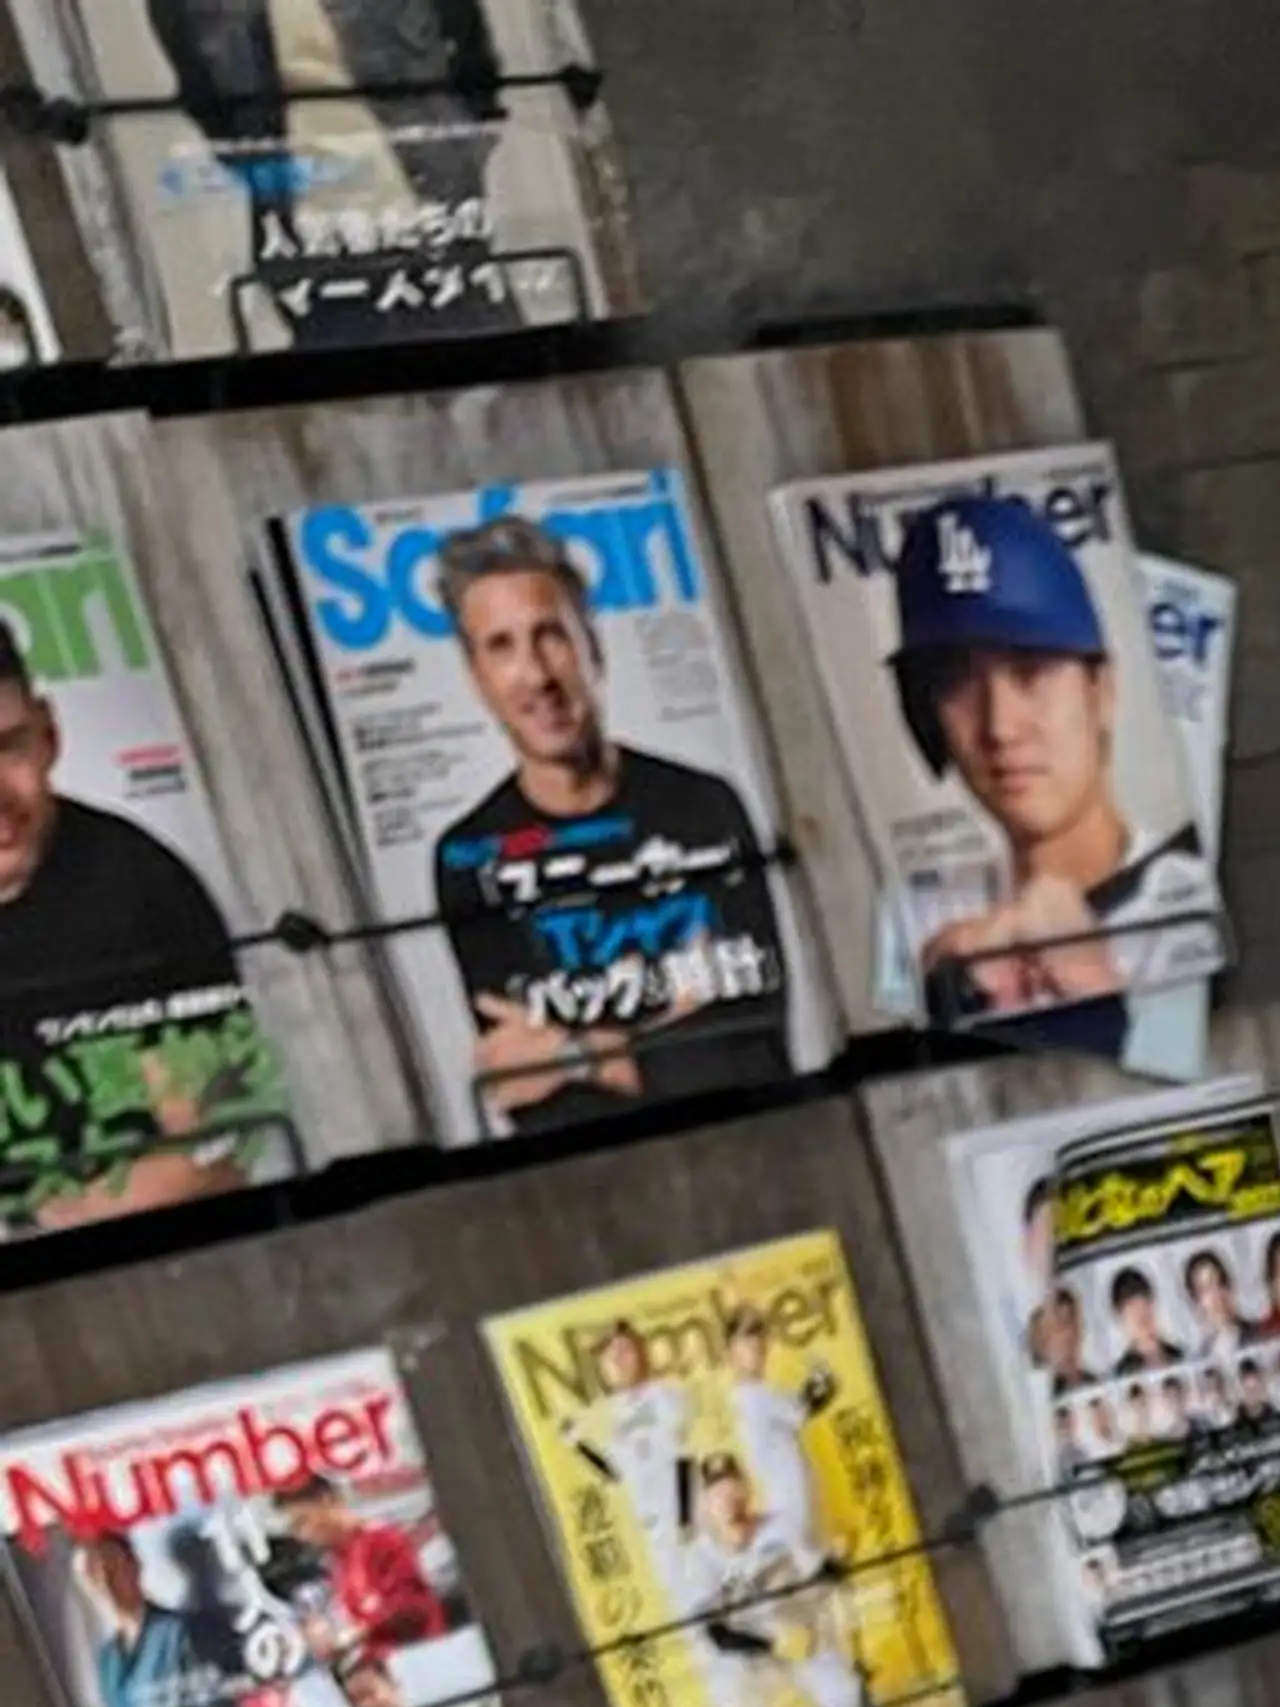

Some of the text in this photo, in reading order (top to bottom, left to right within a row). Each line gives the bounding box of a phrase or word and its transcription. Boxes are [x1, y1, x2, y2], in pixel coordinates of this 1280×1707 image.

[300, 468, 700, 650] Saari
[805, 475, 1111, 584] Nuer
[3, 1397, 395, 1557] Number
